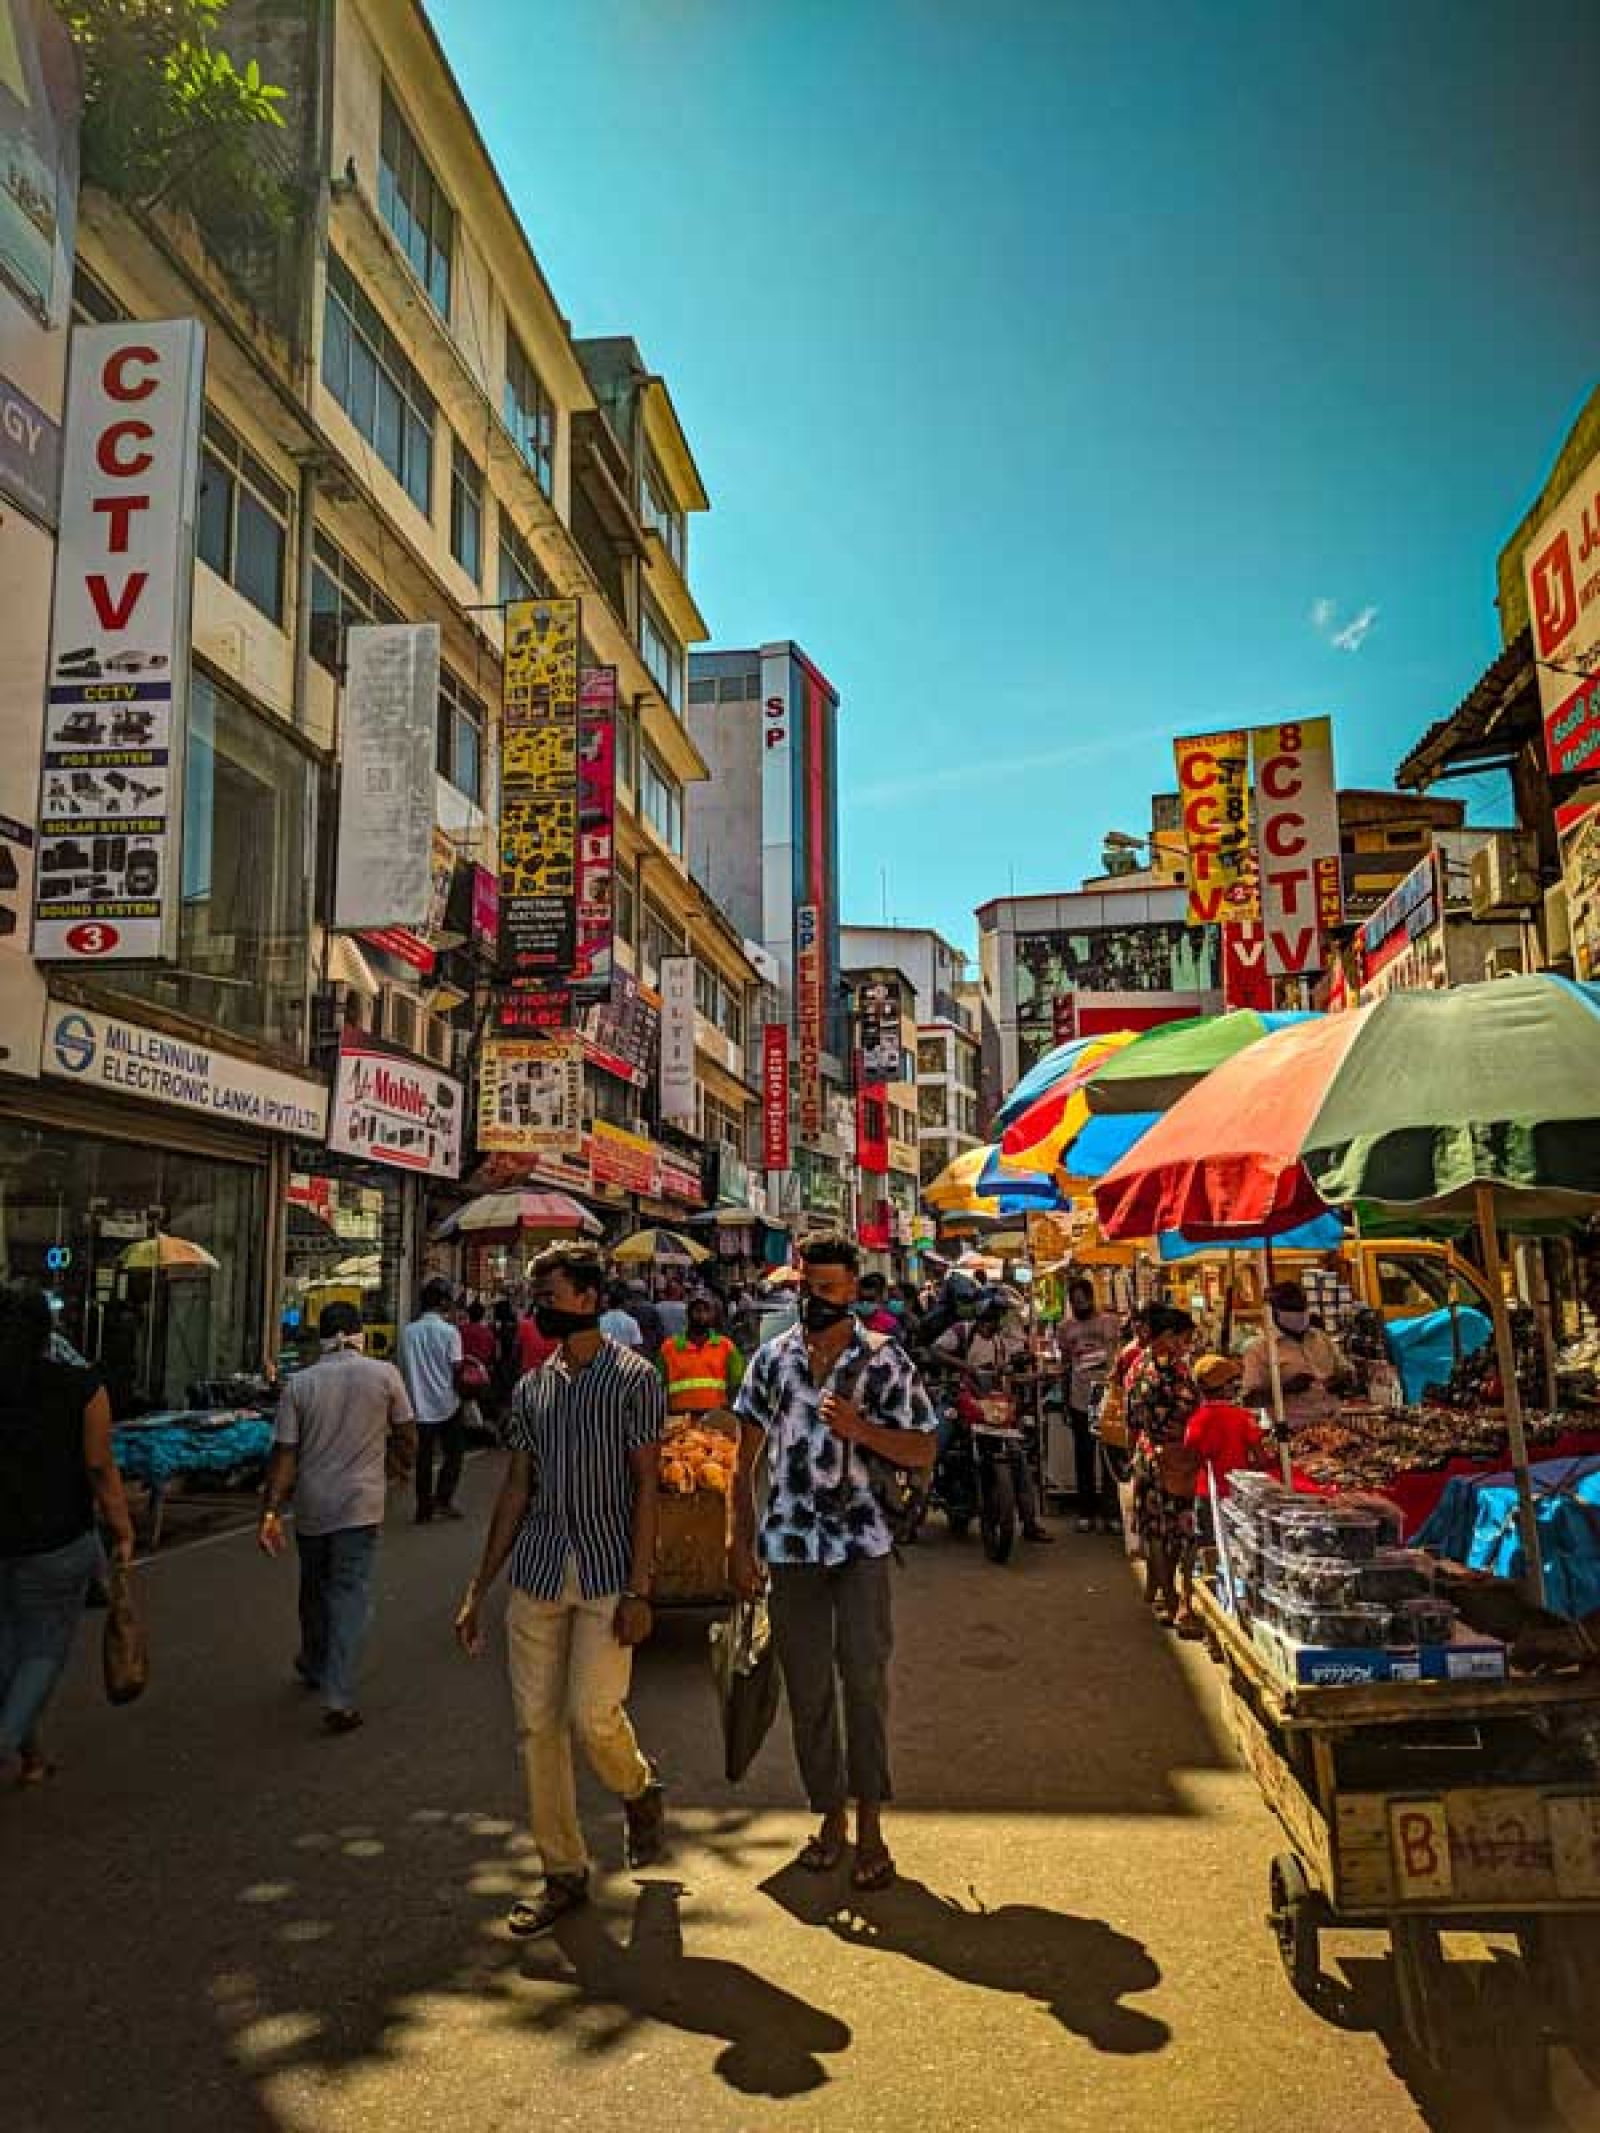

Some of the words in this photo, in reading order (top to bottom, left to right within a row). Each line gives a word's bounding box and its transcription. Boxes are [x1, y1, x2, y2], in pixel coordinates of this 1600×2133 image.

[84, 345, 161, 631] CCTV
[84, 687, 137, 702] CCTV
[1180, 751, 1223, 921] CCTV
[1260, 756, 1314, 971] CCTV
[82, 927, 103, 951] 3
[106, 1024, 210, 1078] MILLENNIUM
[102, 1055, 209, 1105] ELECTRONIC
[212, 1086, 260, 1118] LANKA
